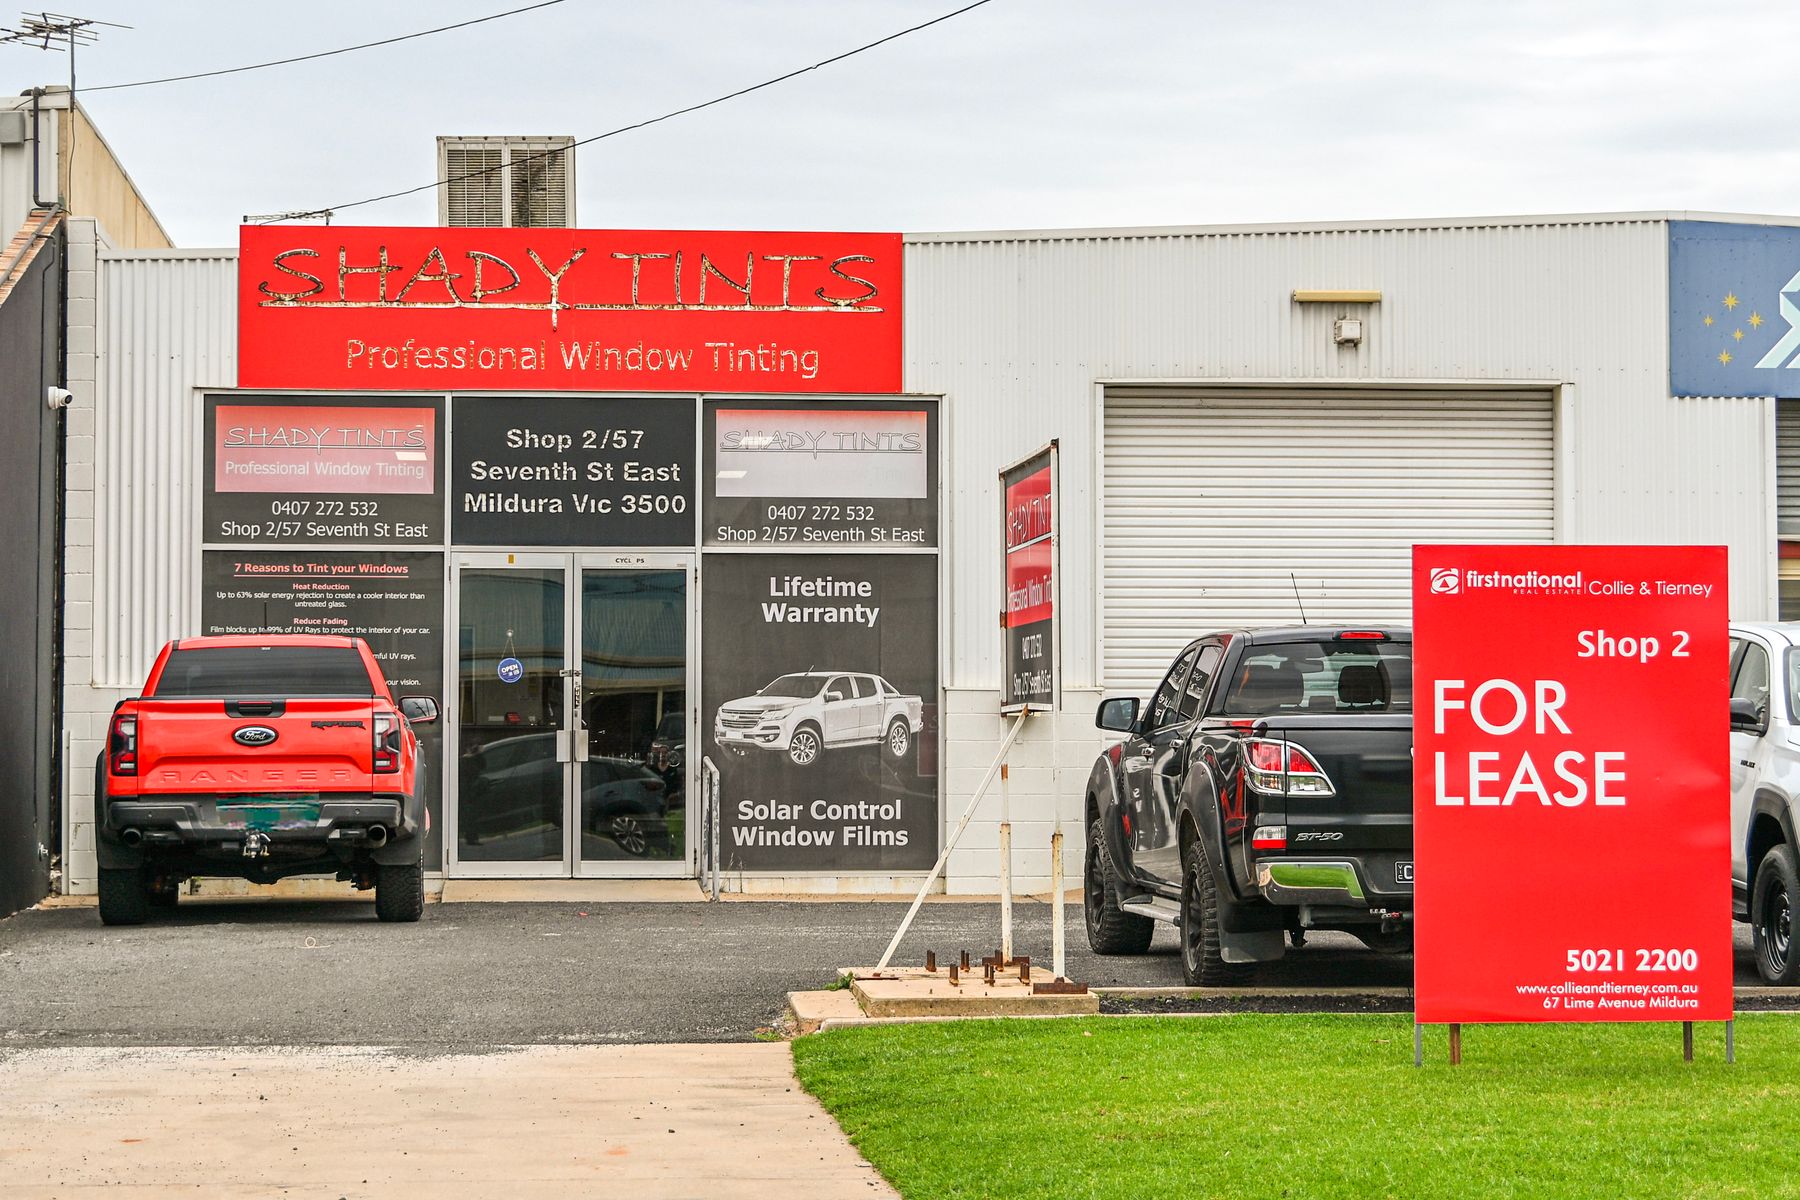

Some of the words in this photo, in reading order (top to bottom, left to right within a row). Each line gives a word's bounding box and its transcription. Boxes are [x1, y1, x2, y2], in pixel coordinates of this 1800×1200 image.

[258, 246, 587, 332] SHADY
[611, 250, 880, 310] TINTS
[347, 338, 547, 370] Professional
[560, 340, 693, 371] Window
[704, 342, 820, 379] Tinting
[224, 427, 330, 455] SHADY
[337, 428, 425, 448] TINTS
[506, 428, 572, 452] Shop
[582, 429, 645, 449] 2/57
[720, 429, 826, 460] SHADY
[833, 431, 922, 451] TINTS
[225, 461, 309, 475] Professional
[314, 462, 371, 475] Window
[376, 462, 425, 478] Tinting
[470, 460, 577, 481] Seventh
[586, 461, 614, 481] St
[623, 462, 681, 481] East
[272, 501, 310, 516] 0407
[315, 501, 344, 516] 272
[350, 502, 378, 516] 532
[464, 493, 563, 513] Mildura
[572, 493, 612, 513] Vic
[621, 494, 687, 514] 3500
[768, 505, 806, 520] 0407
[811, 506, 841, 520] 272
[846, 506, 875, 521] 532
[1008, 498, 1033, 551] SHADY
[1033, 493, 1052, 539] TINT
[221, 521, 261, 539] Shop
[266, 522, 301, 539] 2/57
[306, 522, 368, 537] Seventh
[374, 523, 390, 537] St
[395, 523, 428, 538] East
[717, 526, 756, 544] Shop
[762, 526, 797, 543] 2/57
[802, 526, 865, 542] Seventh
[870, 527, 887, 542] St
[892, 528, 925, 542] East
[234, 563, 241, 572] 7
[244, 563, 290, 572] Reasons
[292, 564, 304, 572] to
[306, 563, 329, 572] Tint
[331, 565, 356, 574] your
[359, 563, 409, 573] Windows
[216, 591, 226, 599] Up
[271, 592, 294, 600] energy
[296, 592, 324, 600] rejection
[770, 576, 872, 597] Lifetime
[1588, 580, 1634, 595] Collie
[1639, 581, 1651, 595] &
[1655, 580, 1713, 598] Tierney
[328, 601, 347, 609] glass.
[323, 618, 348, 626] Fading
[761, 603, 880, 628] Warranty
[305, 626, 321, 634] Rays
[1577, 629, 1659, 663] Shop
[1671, 630, 1690, 657] 2
[400, 653, 417, 661] rays.
[1434, 678, 1572, 735] FOR
[243, 729, 266, 741] Ford
[159, 769, 351, 783] RANGER
[1435, 750, 1626, 806] LEASE
[738, 799, 803, 820] Solar
[810, 799, 901, 820] Control
[731, 826, 835, 846] Window
[842, 826, 908, 846] Films
[1295, 832, 1344, 841] BT-50
[1565, 949, 1625, 971] 5021
[1636, 949, 1698, 971] 2200
[1516, 982, 1698, 997] www.collieandtierney.com.au
[1543, 997, 1559, 1009] 67
[1564, 996, 1594, 1008] Lime
[1598, 997, 1645, 1008] Avenue
[1649, 996, 1698, 1008] Mildura
